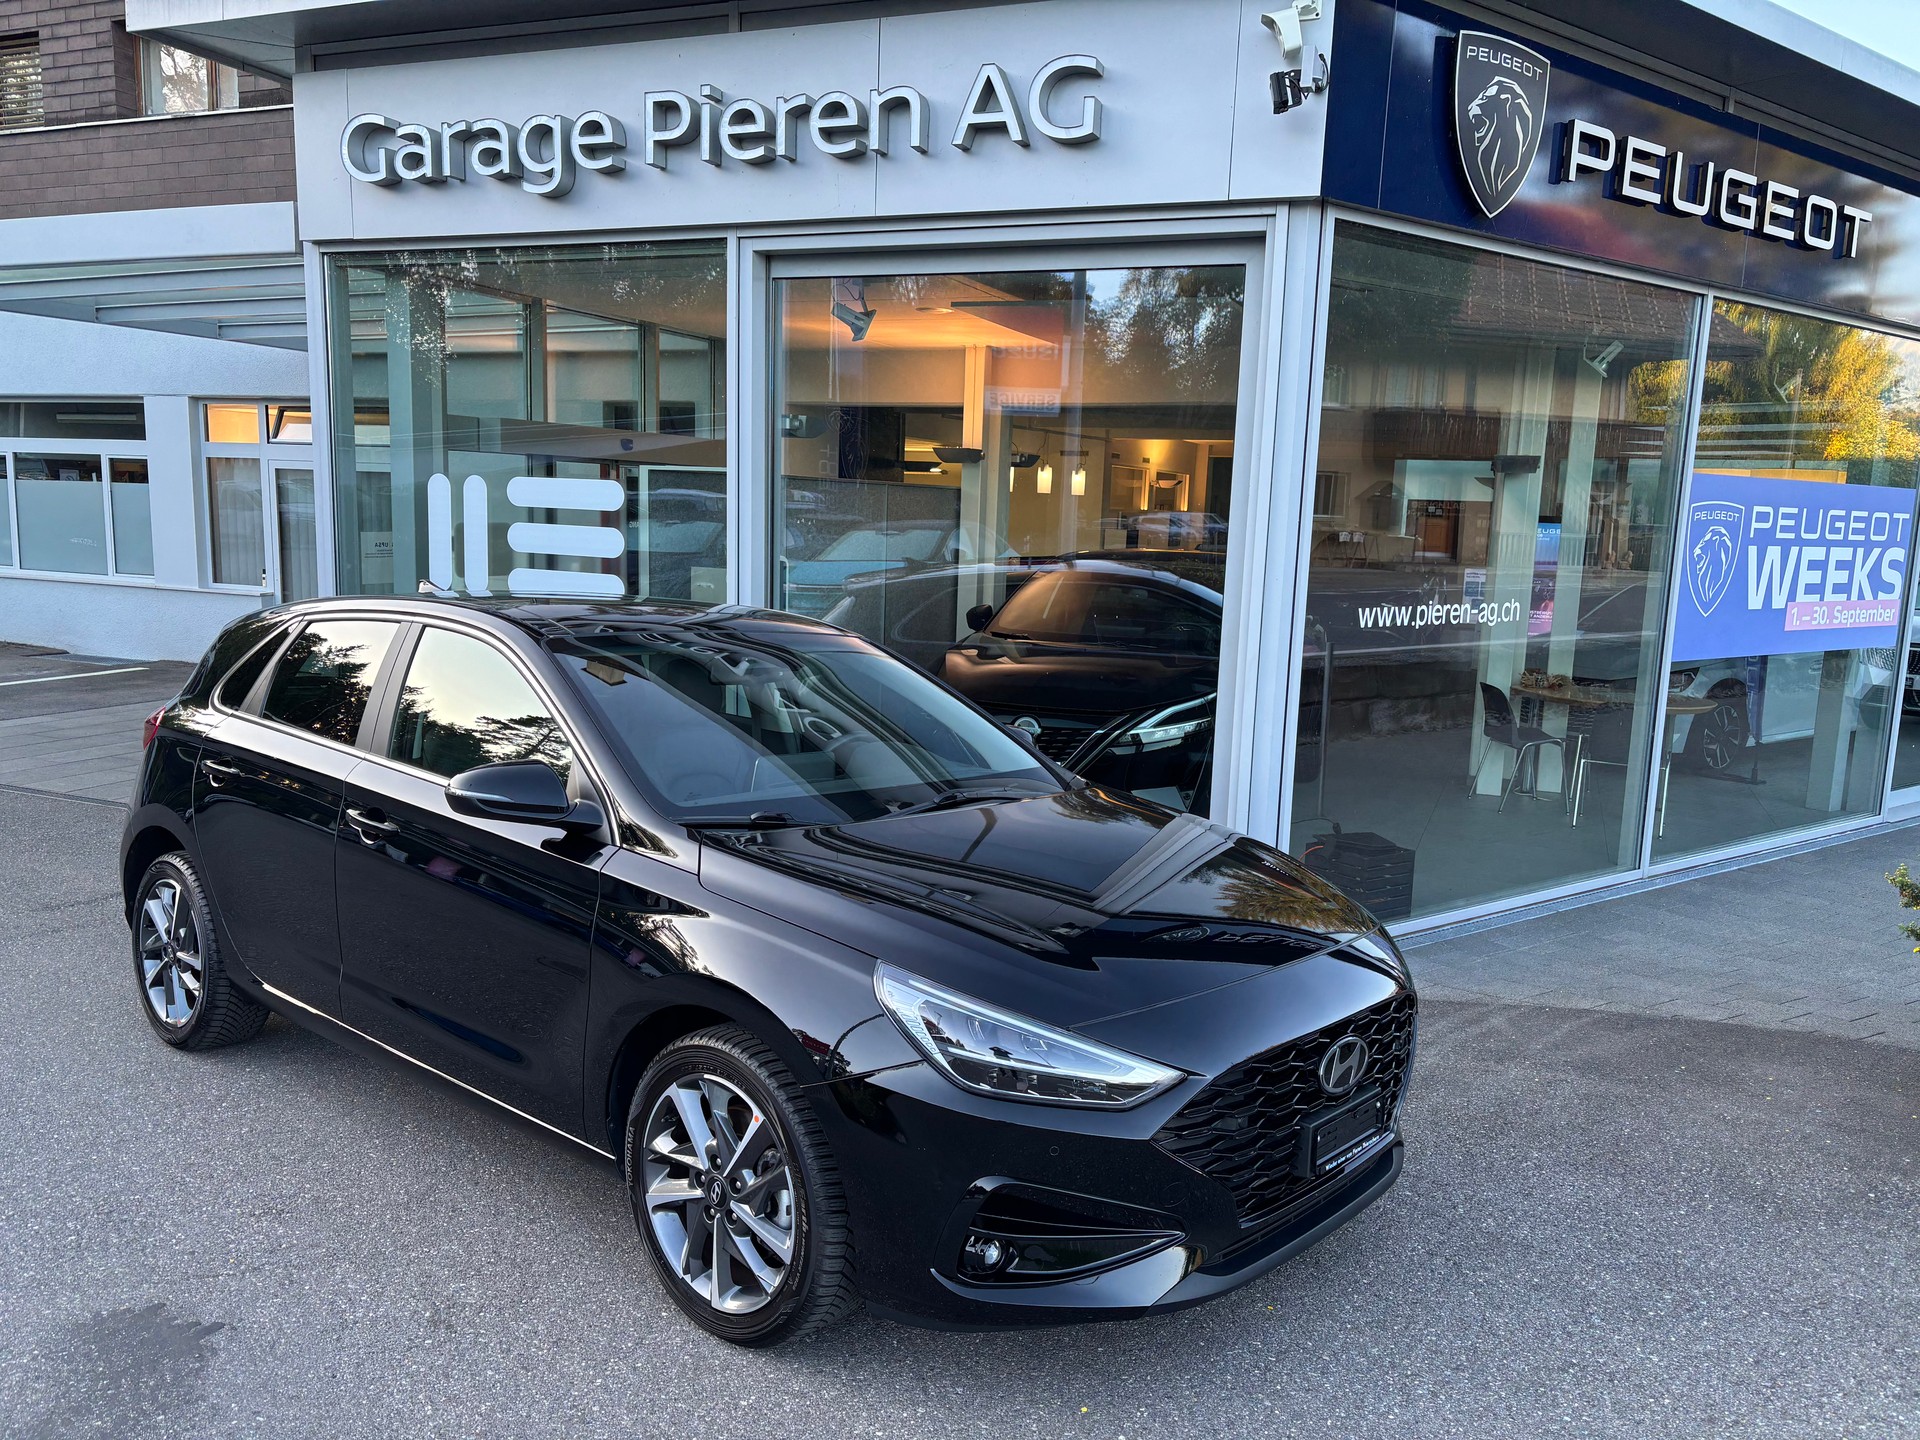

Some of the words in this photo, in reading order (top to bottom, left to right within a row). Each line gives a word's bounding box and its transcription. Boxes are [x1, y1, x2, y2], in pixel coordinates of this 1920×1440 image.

[1466, 45, 1543, 81] PEUGEOT
[340, 109, 627, 198] Garage
[644, 83, 929, 170] Pieren
[951, 54, 1104, 151] AG
[1565, 118, 1873, 259] PEUGEOT
[1694, 510, 1740, 522] PEUGEOT
[1749, 505, 1910, 542] PEUGEOT
[1747, 545, 1906, 610] WEEKS
[1358, 599, 1520, 629] www.pieren-ag.ch
[1832, 605, 1896, 628] September
[626, 1126, 636, 1187] YOKOHAMA
